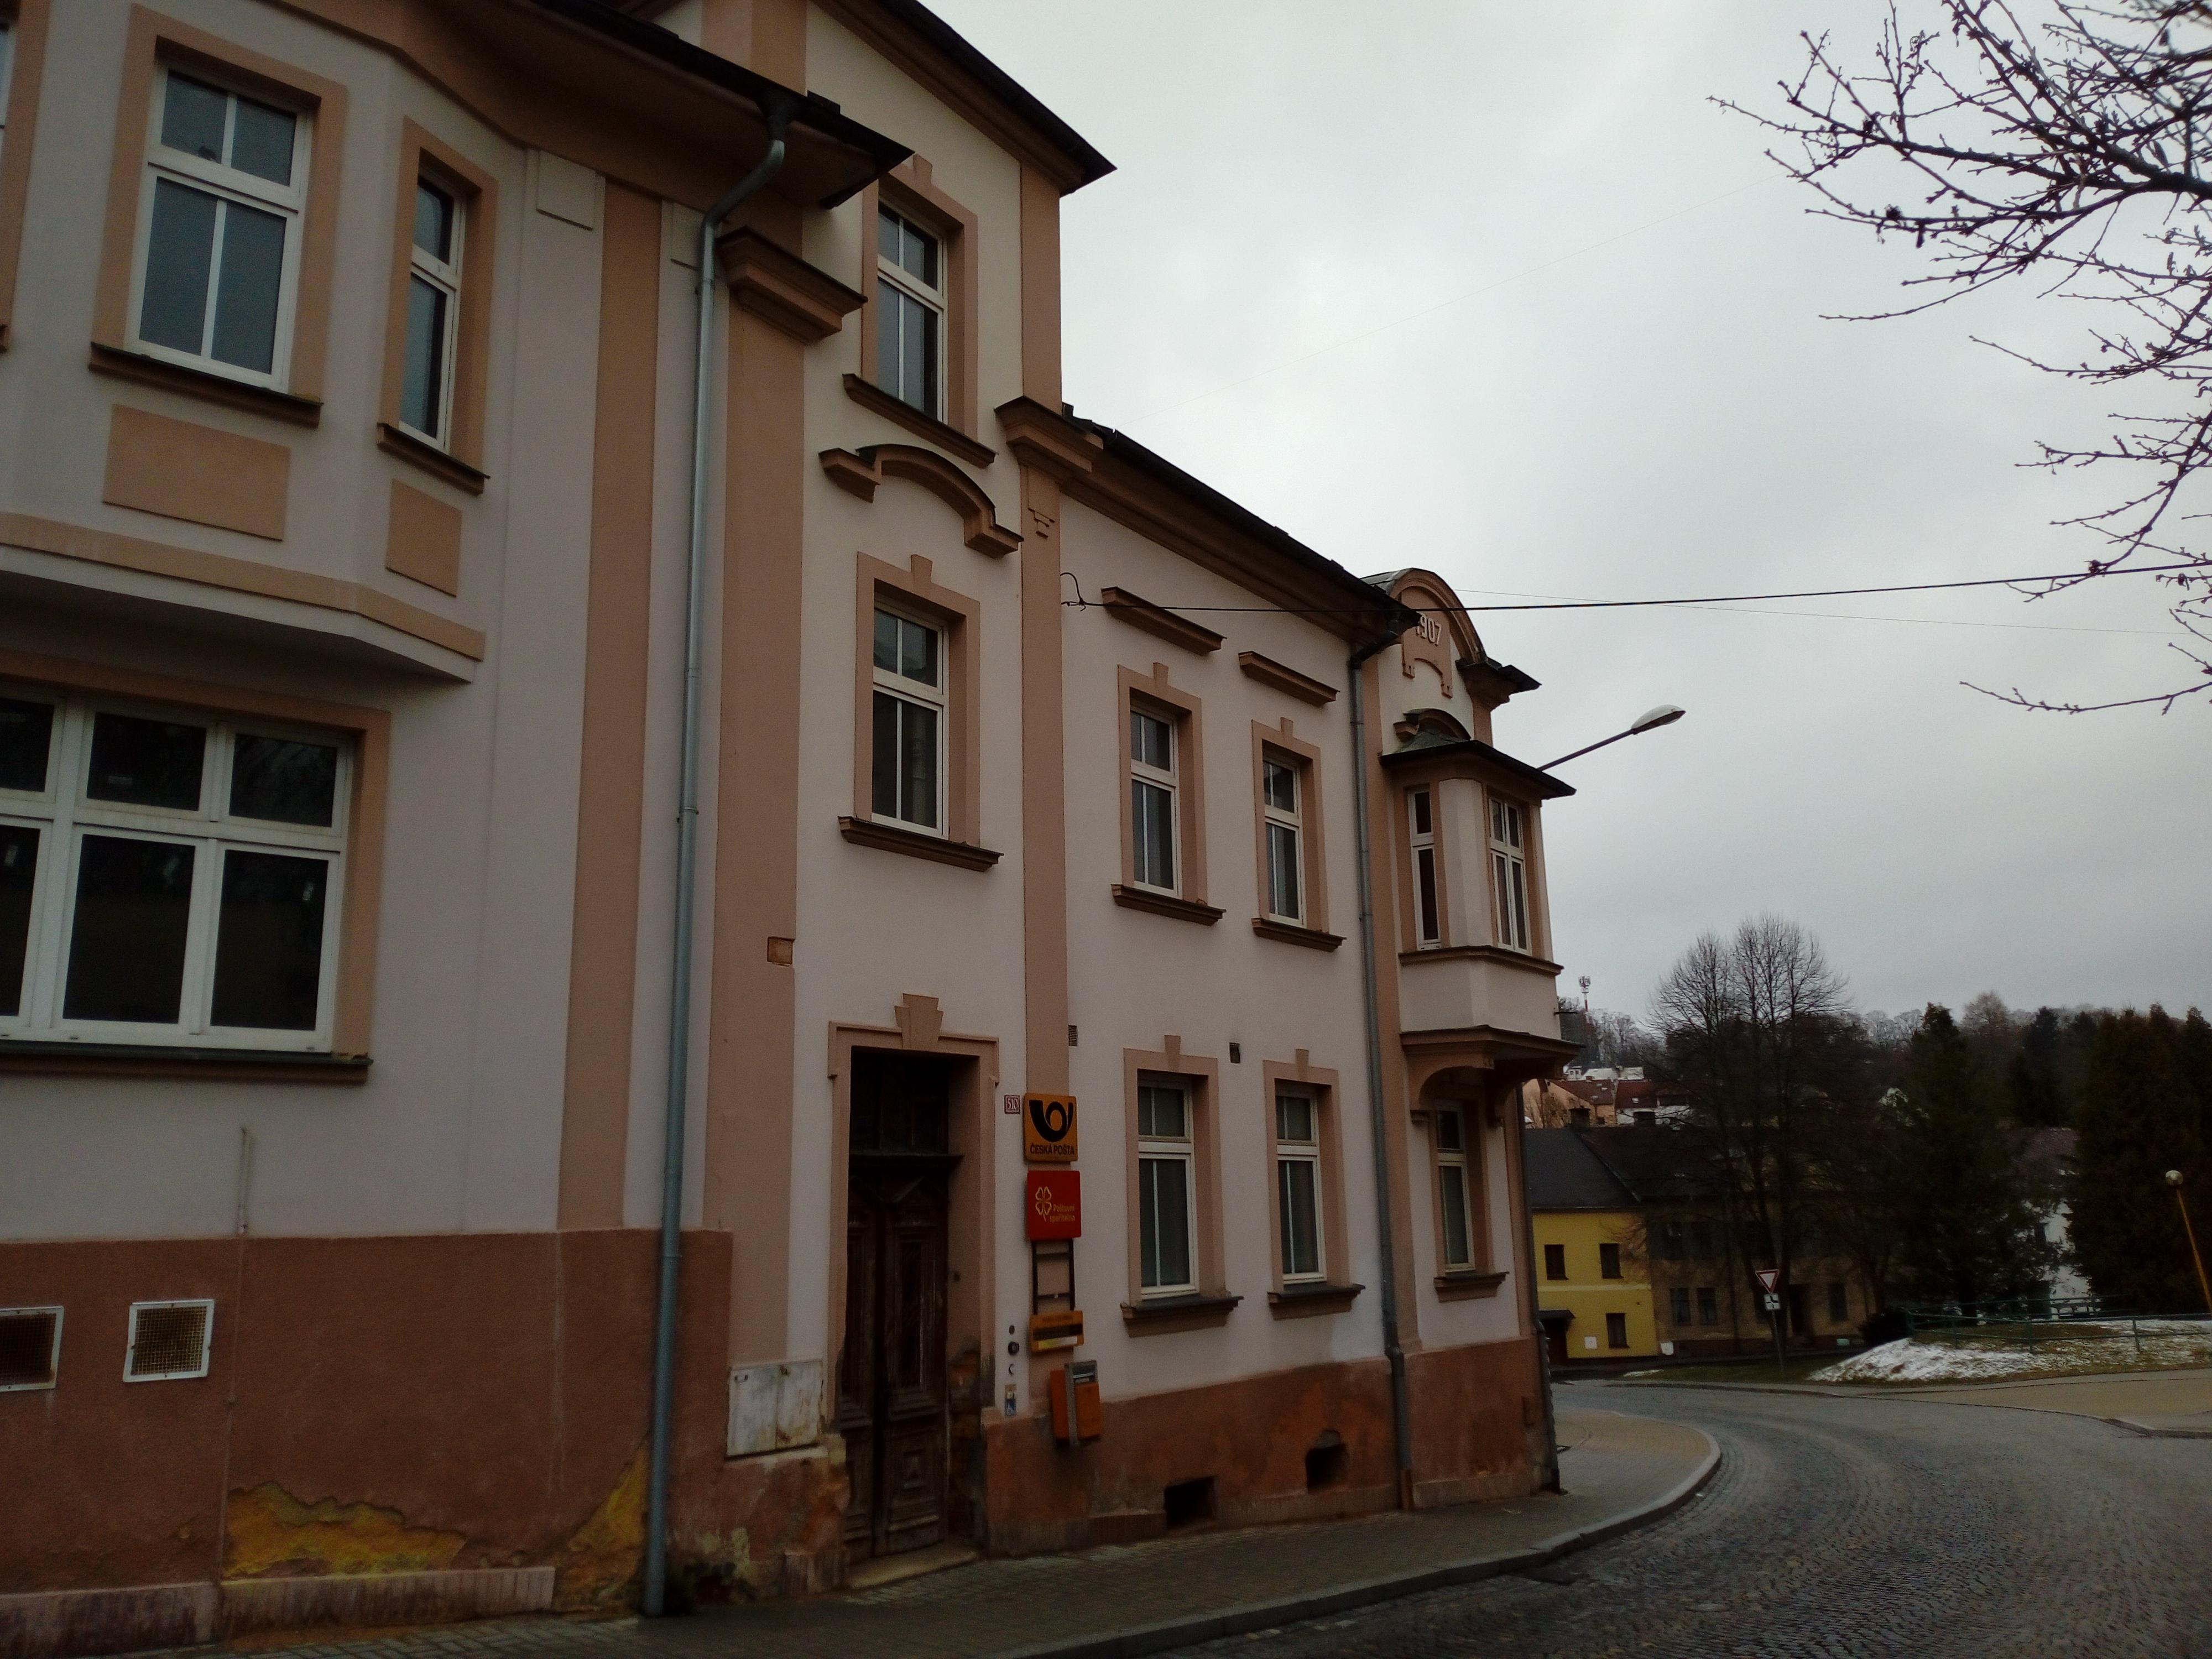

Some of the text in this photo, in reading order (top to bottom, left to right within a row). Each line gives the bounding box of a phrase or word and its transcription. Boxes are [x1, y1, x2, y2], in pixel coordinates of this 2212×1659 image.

[1416, 613, 1442, 646] 907
[1030, 1142, 1075, 1155] ČESKÁ POŠTA
